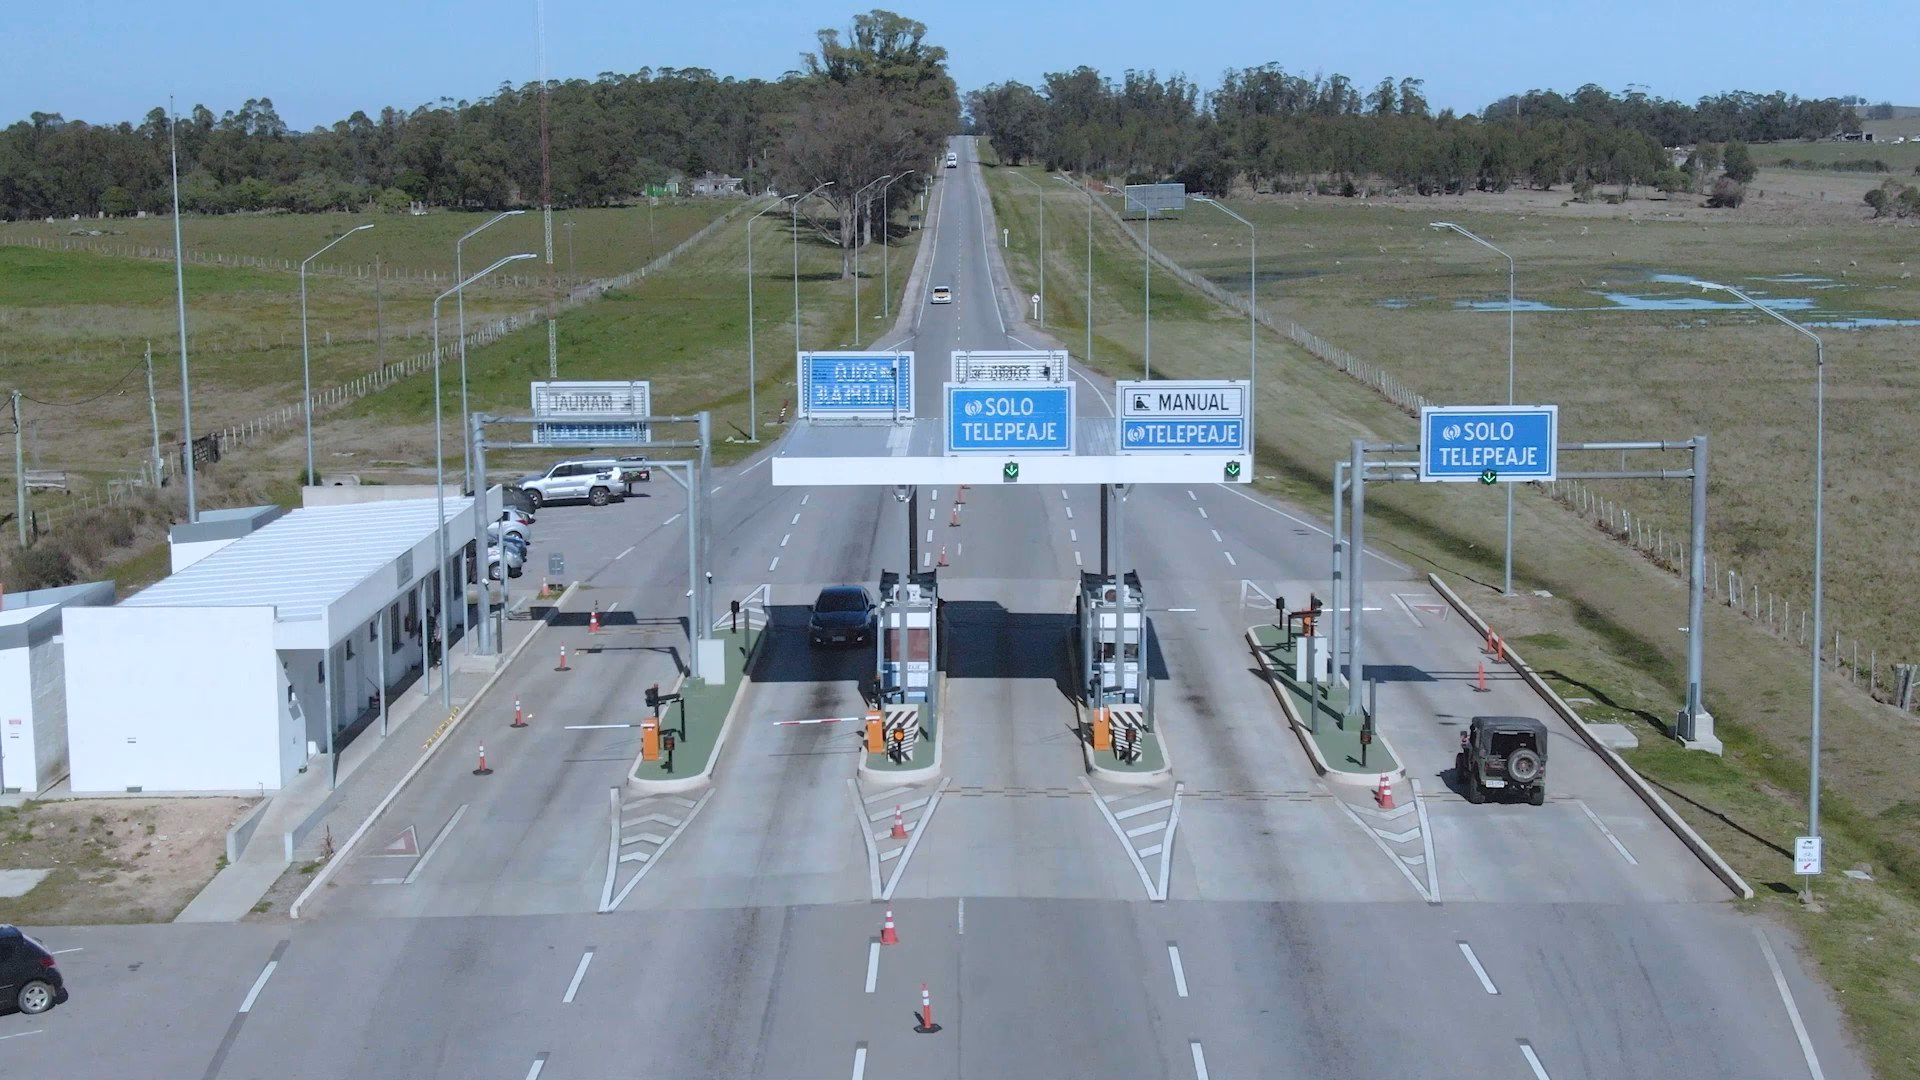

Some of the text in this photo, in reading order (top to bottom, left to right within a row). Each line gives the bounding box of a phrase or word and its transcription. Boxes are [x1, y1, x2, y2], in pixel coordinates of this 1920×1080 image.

[985, 397, 1034, 416] SOLO
[1159, 393, 1229, 411] MANUAL
[961, 422, 1057, 441] TELEPEAJE
[1145, 425, 1237, 443] TELEPEAJE
[1464, 422, 1514, 441] SOLO
[1439, 447, 1537, 466] TELEPEAJE
